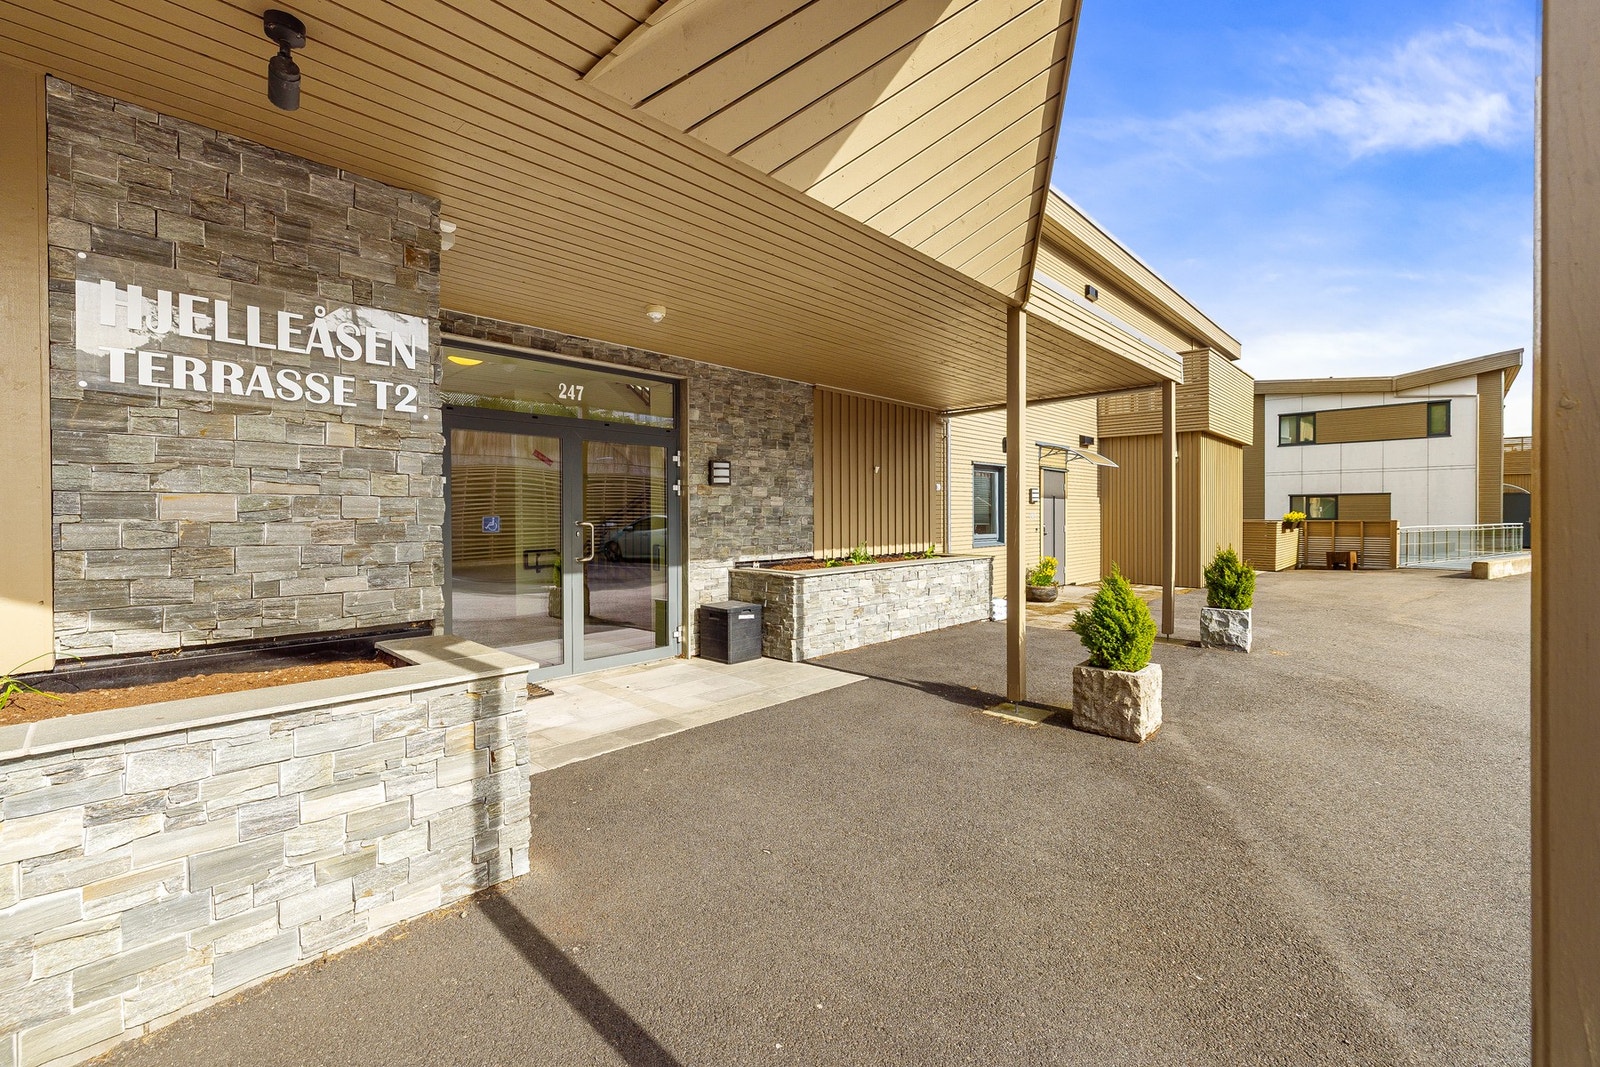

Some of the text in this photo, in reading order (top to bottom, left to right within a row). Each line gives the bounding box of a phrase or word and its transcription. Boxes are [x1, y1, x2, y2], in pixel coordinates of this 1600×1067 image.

[100, 279, 416, 370] HJELLEÅSEN
[99, 346, 418, 413] TERRASSE T2
[558, 382, 584, 401] 247
